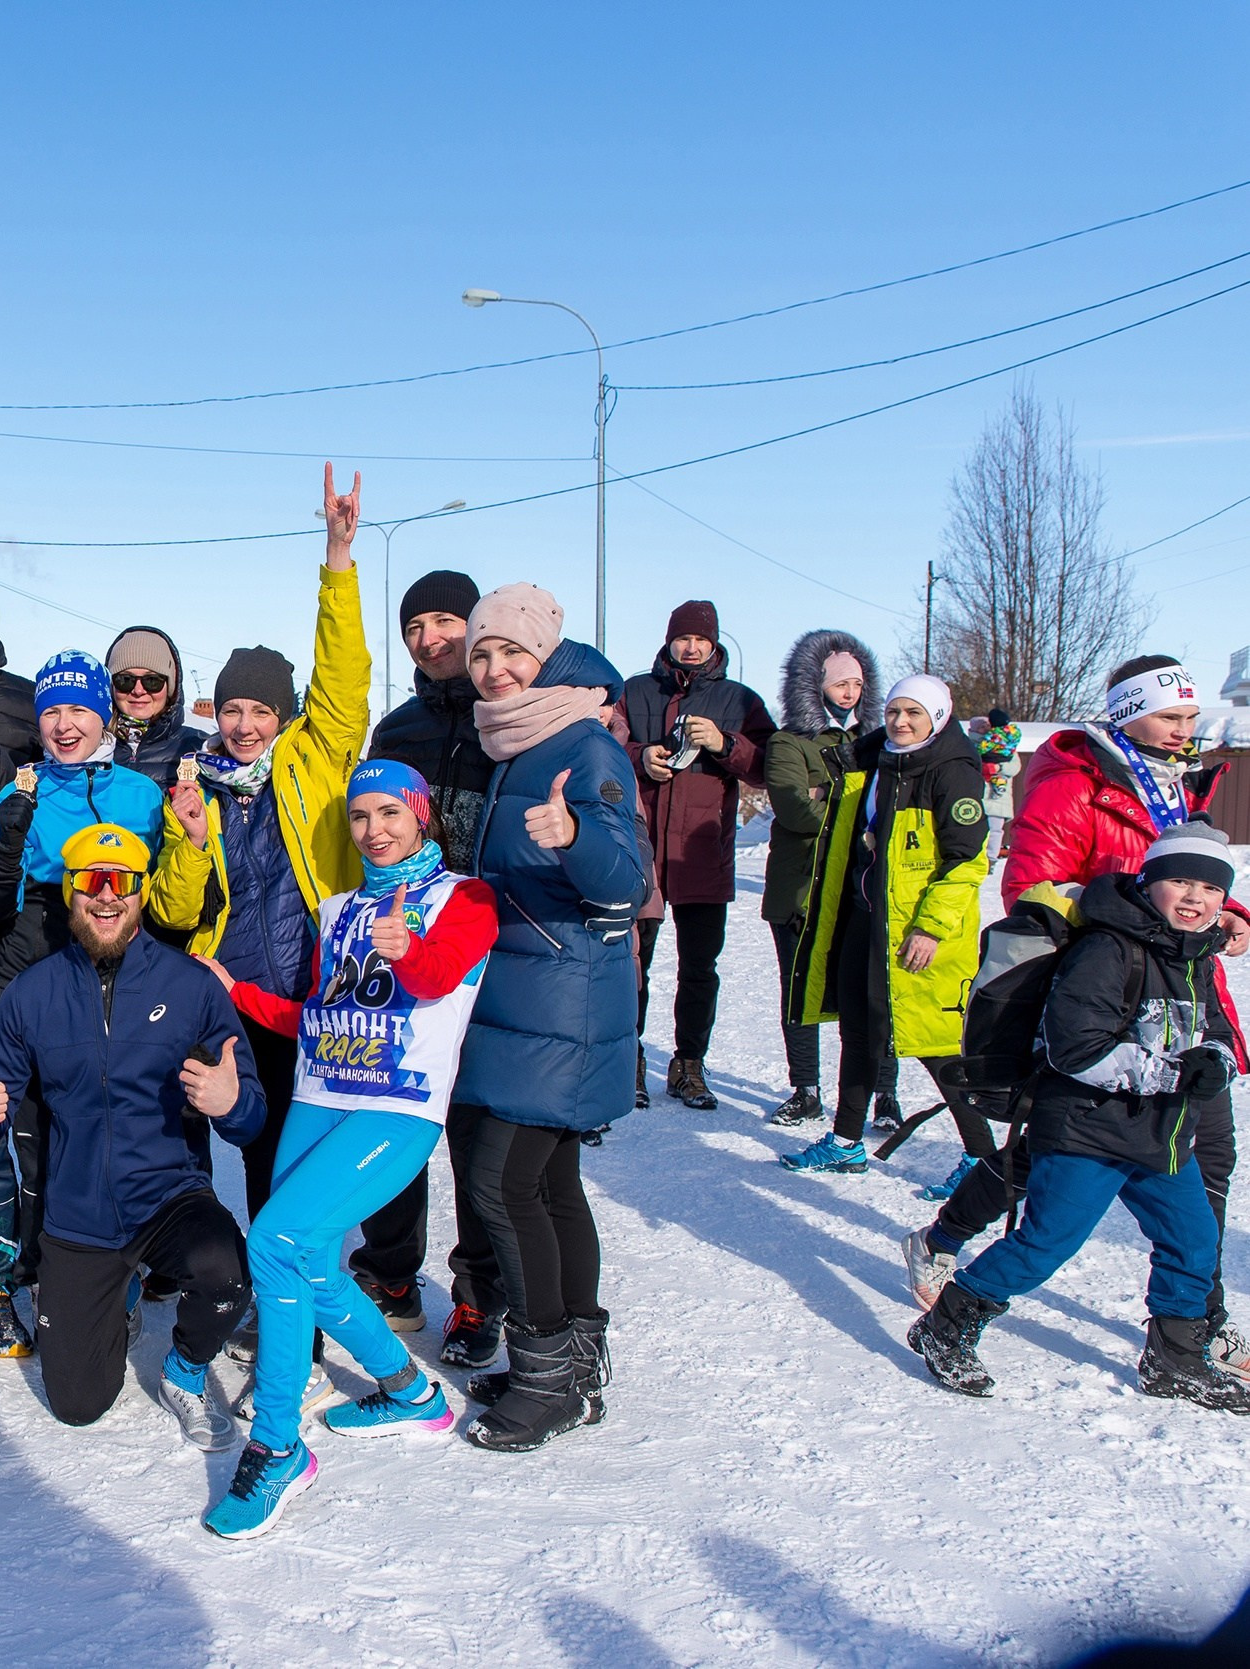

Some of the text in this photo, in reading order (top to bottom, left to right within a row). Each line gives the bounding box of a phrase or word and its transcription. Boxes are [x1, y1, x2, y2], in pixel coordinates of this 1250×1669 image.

[73, 682, 89, 690] 2021
[315, 1032, 388, 1067] RACE
[311, 1064, 390, 1084] ХАНТЫ-МАНСИЙСК
[356, 1140, 390, 1171] NORDSKI
